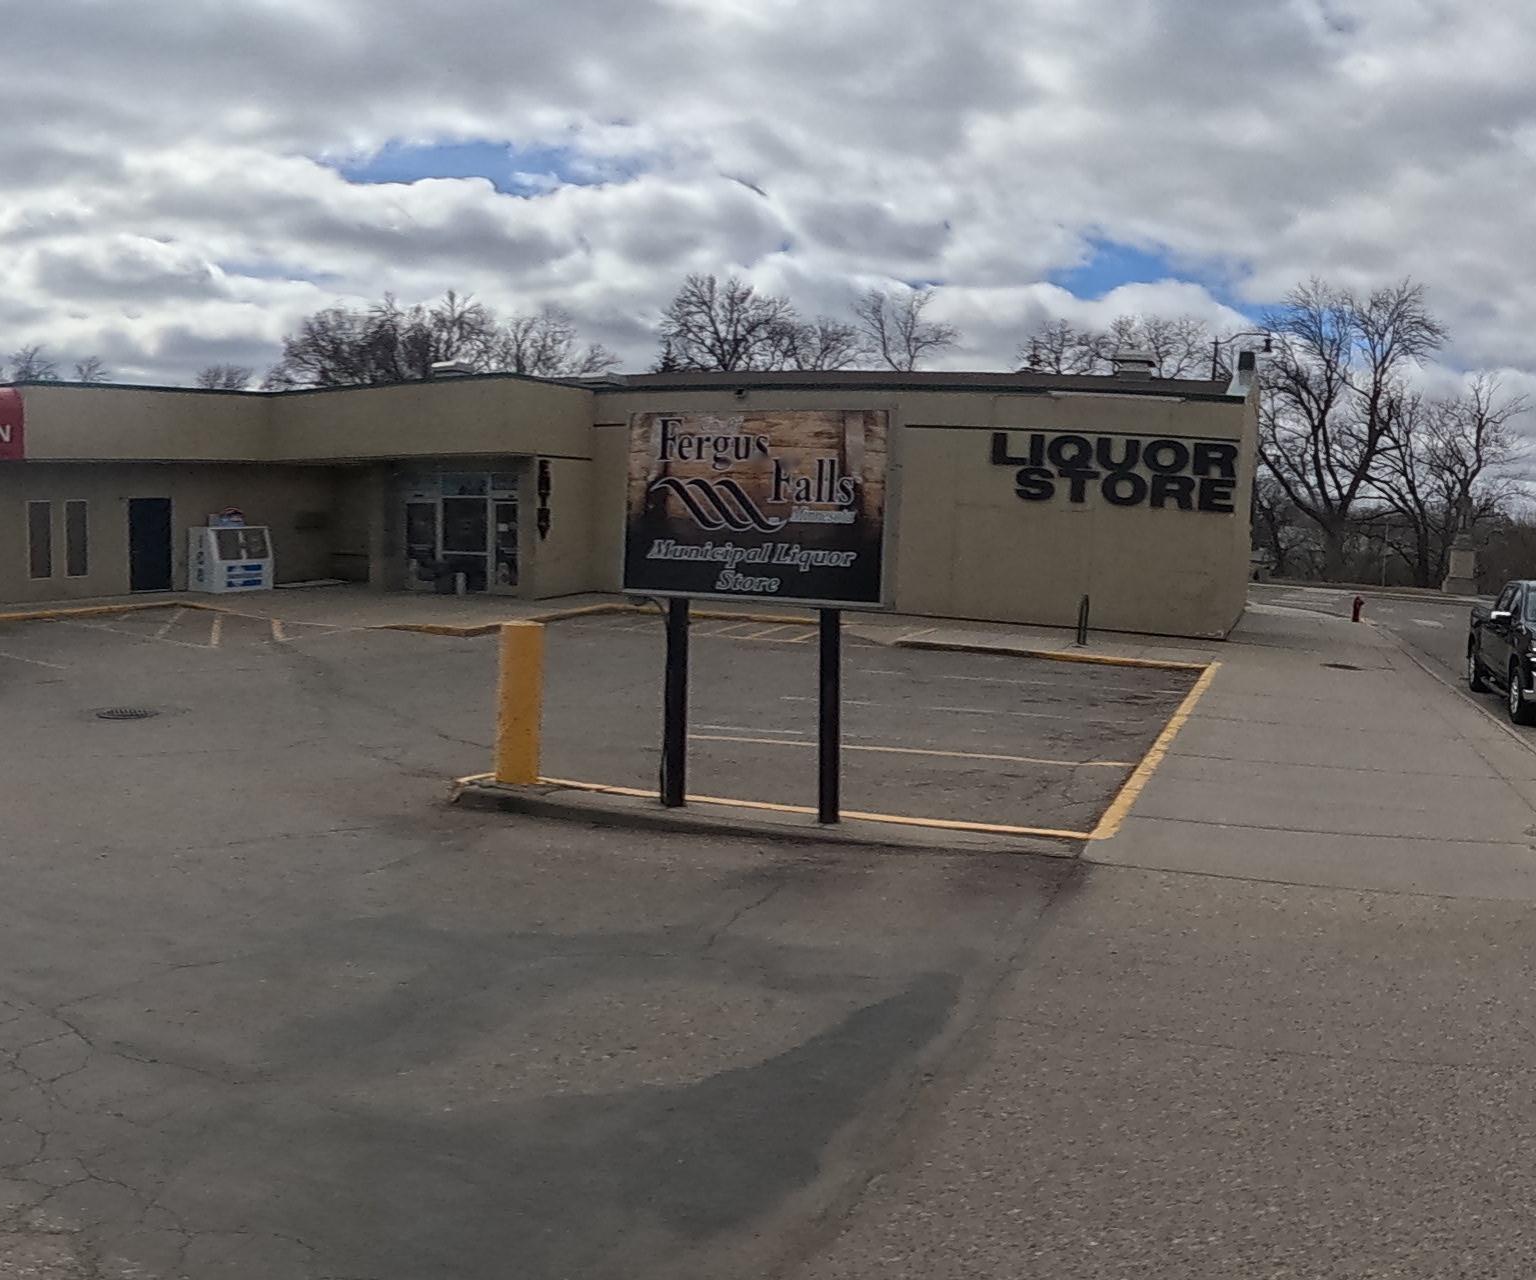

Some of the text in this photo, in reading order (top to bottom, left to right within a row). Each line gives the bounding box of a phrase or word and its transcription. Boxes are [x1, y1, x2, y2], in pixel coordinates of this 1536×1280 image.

[657, 417, 770, 471] Fergus
[991, 432, 1238, 478] LIQUOR
[767, 457, 857, 505] Falls
[1015, 467, 1236, 513] STORE
[646, 539, 857, 572] Municipal Liquor
[715, 570, 781, 592] Store
